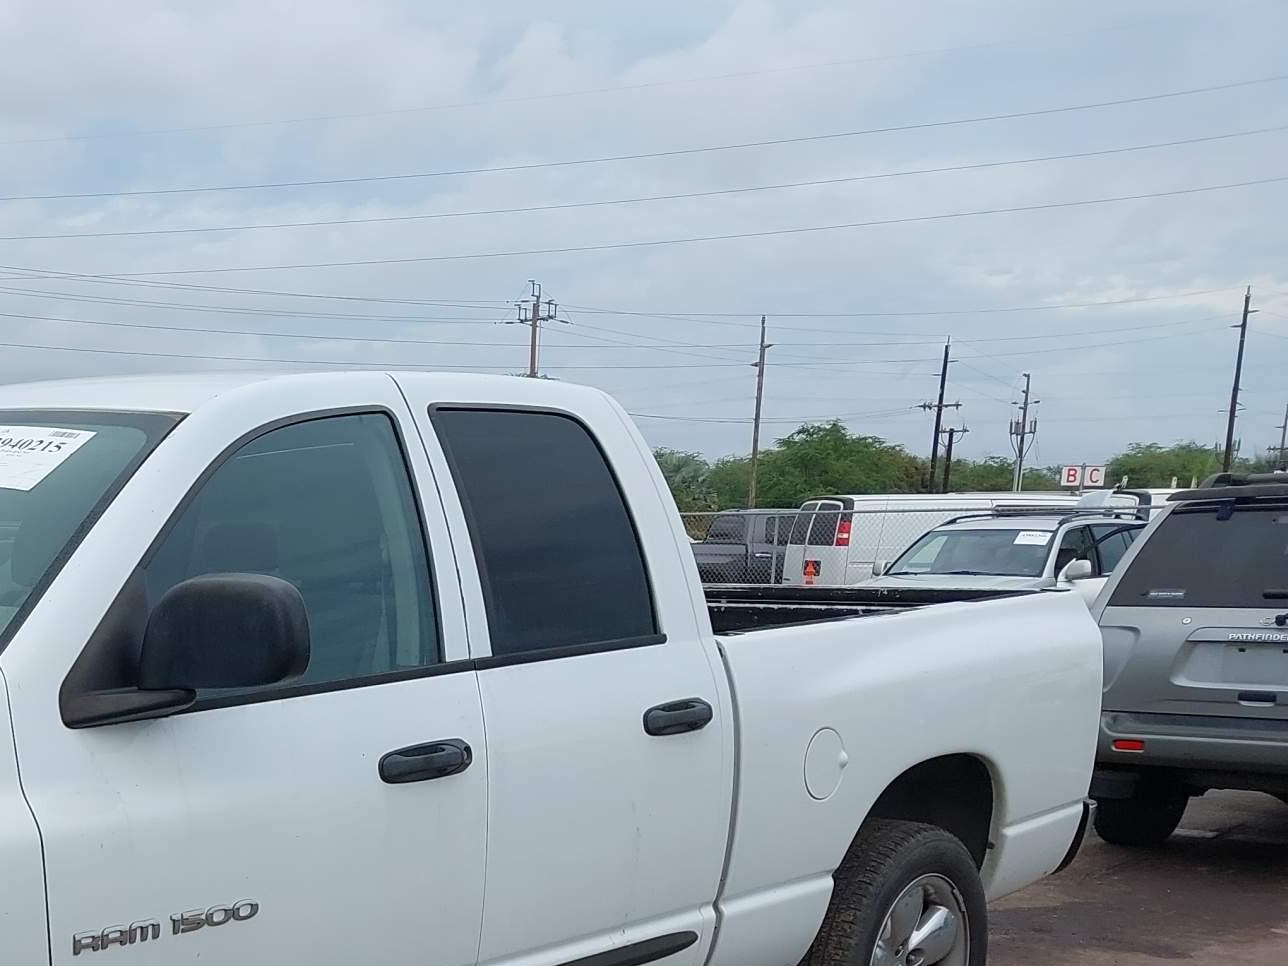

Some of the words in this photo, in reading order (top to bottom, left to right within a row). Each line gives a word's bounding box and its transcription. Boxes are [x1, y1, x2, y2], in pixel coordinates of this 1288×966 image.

[1067, 468, 1077, 483] B
[1089, 468, 1100, 483] C
[1228, 633, 1288, 641] PATHFINDE
[73, 918, 161, 956] RAM
[170, 899, 260, 935] 1500
